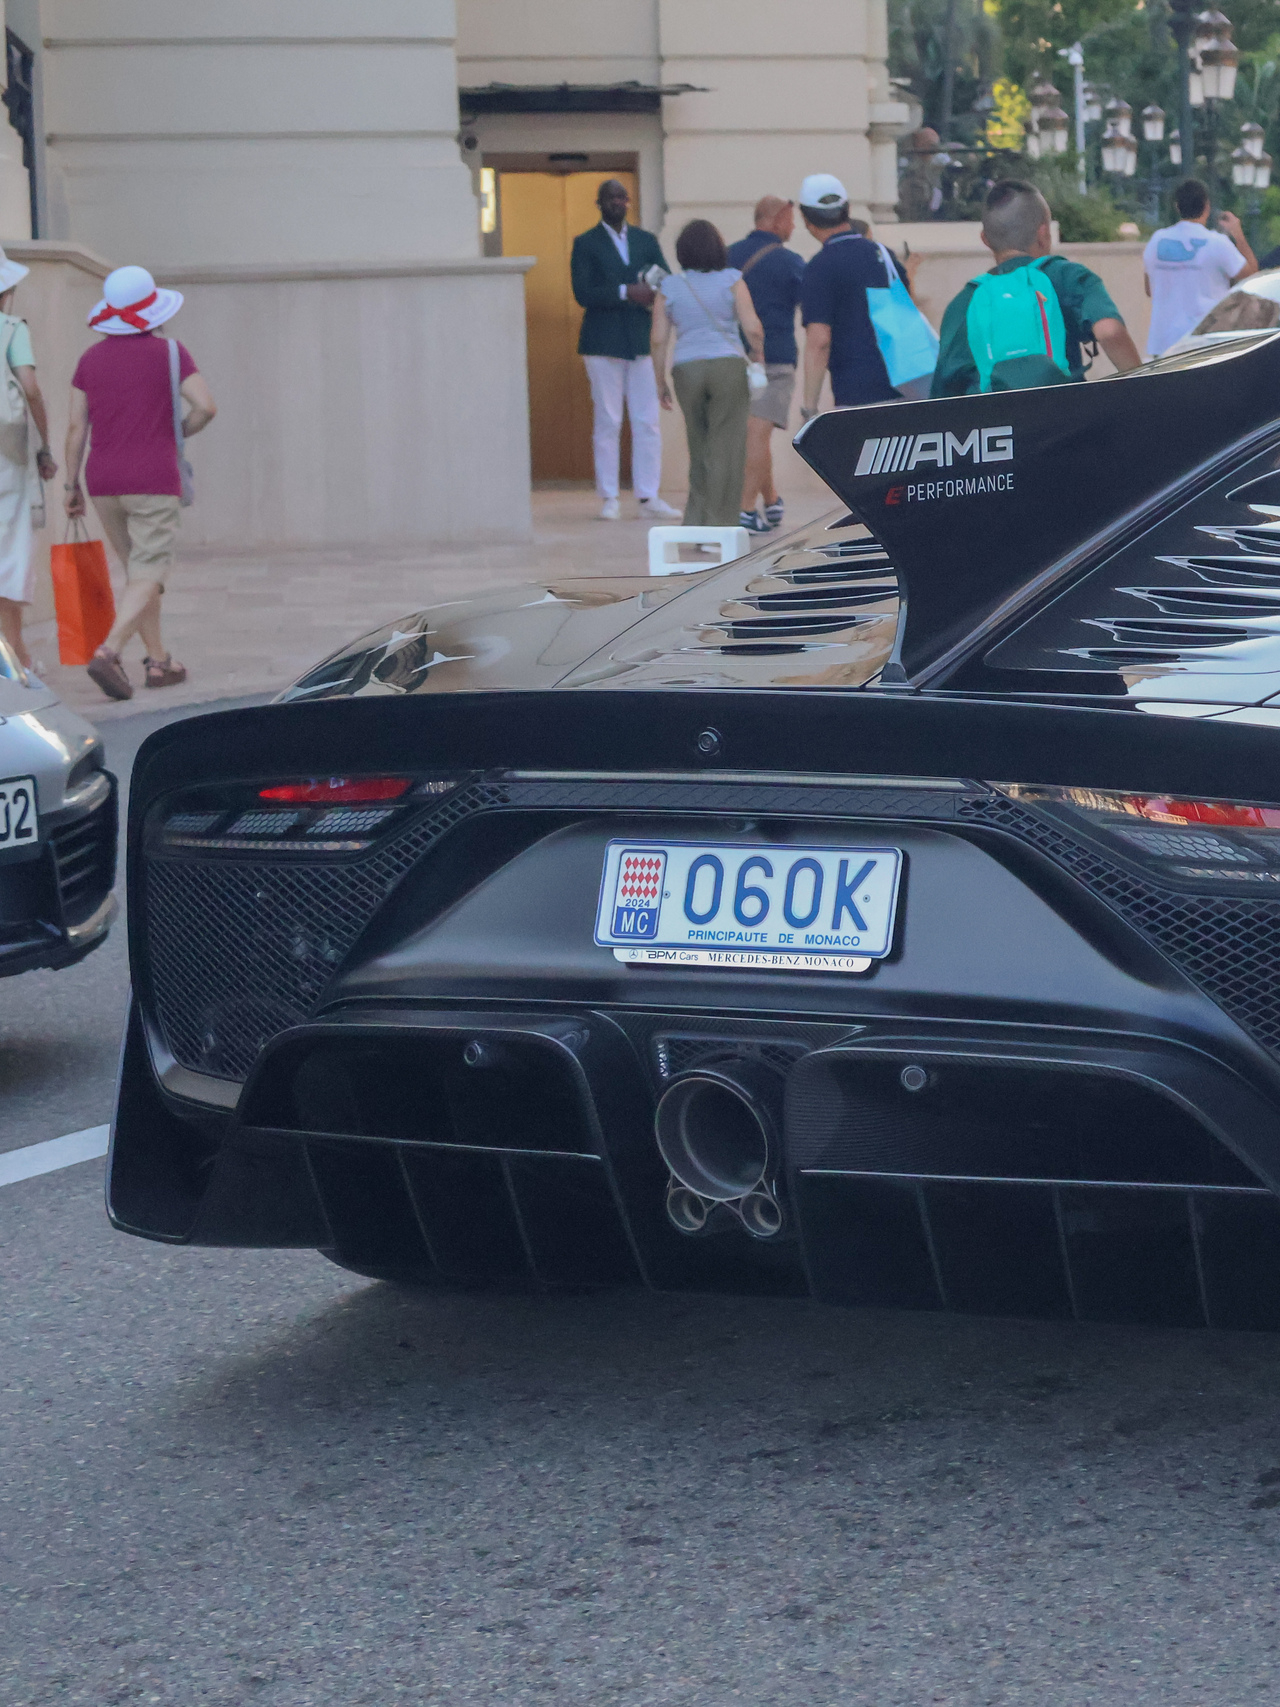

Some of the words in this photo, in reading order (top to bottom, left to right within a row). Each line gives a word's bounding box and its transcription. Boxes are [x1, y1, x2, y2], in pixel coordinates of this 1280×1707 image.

[907, 473, 1014, 502] PERFORMANCE
[683, 854, 877, 931] 060K
[624, 898, 650, 908] 2024
[620, 911, 649, 934] MC
[687, 930, 768, 944] PRINCIPAUTE
[778, 933, 795, 944] DE
[804, 934, 861, 947] MONACO
[646, 950, 677, 960] BPM
[679, 952, 699, 961] Cars
[708, 952, 800, 966] MERCEDES-BENZ
[804, 956, 854, 968] MONACO
